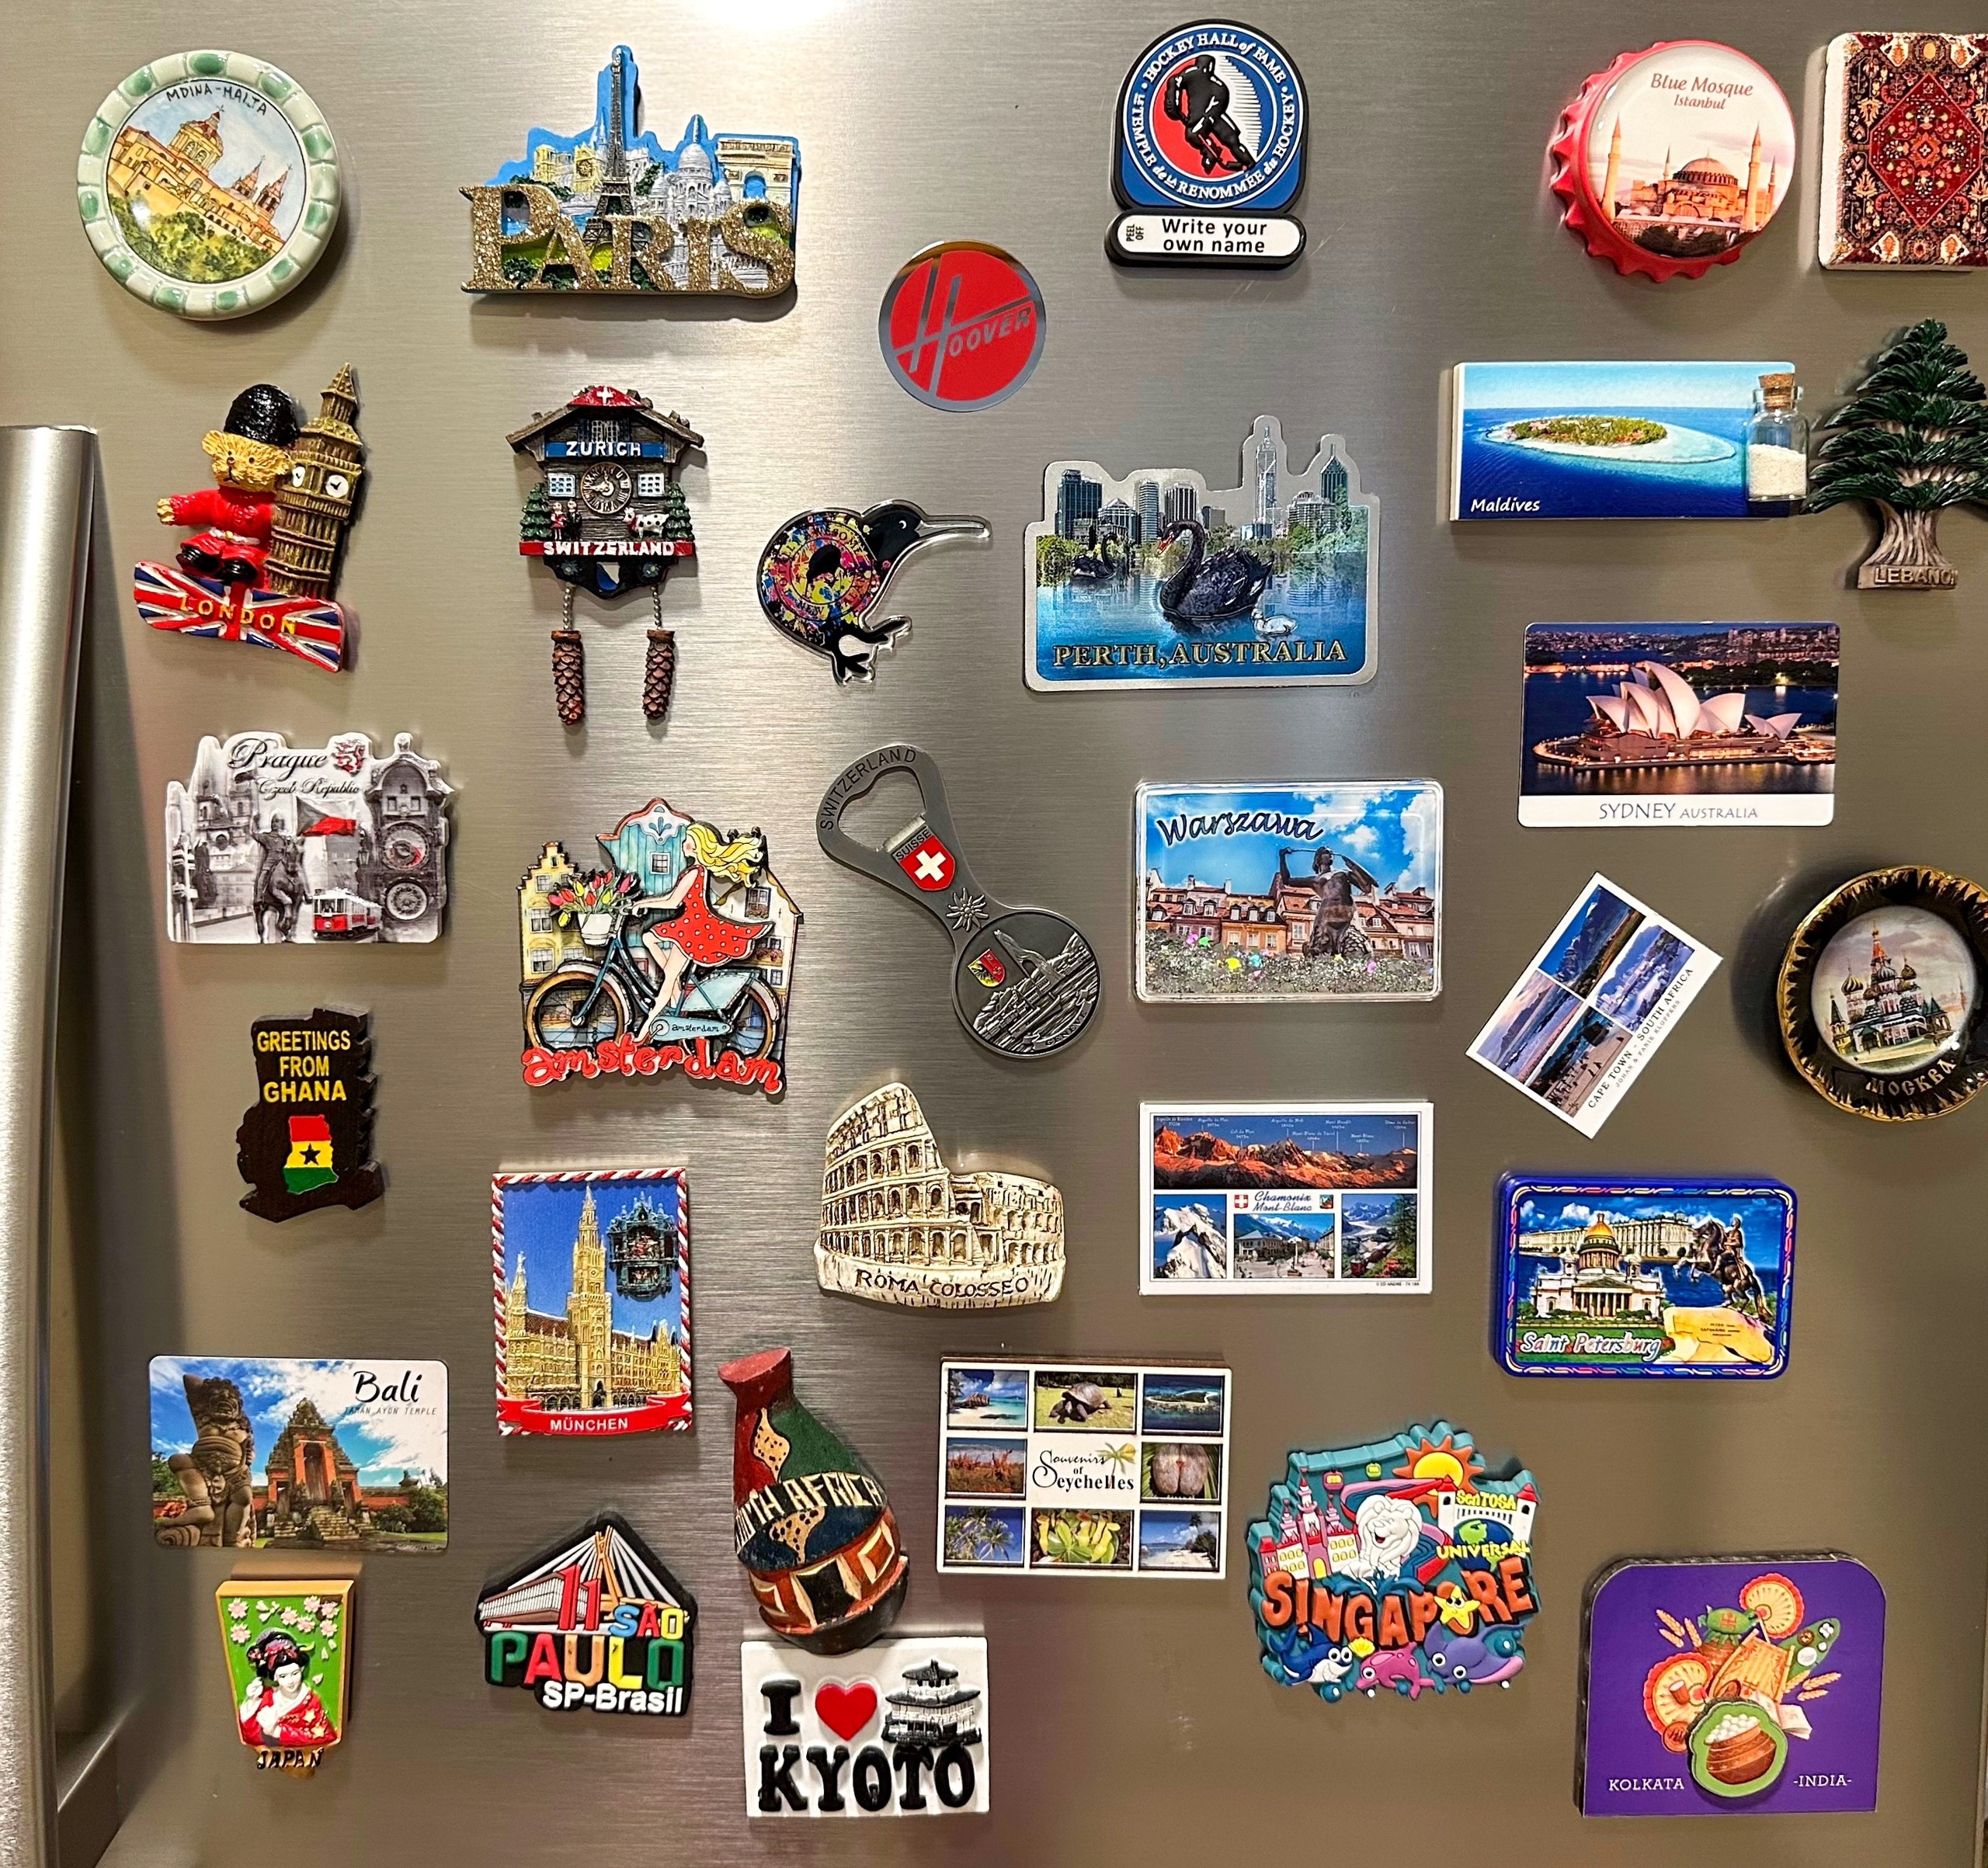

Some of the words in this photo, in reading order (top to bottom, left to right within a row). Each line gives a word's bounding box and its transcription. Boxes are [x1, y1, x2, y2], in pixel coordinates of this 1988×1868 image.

[1144, 39, 1194, 83] HOCKEY
[1197, 33, 1238, 47] HALL
[1238, 40, 1256, 54] of
[1255, 46, 1287, 83] FAME
[1650, 73, 1688, 90] Blue
[1691, 76, 1753, 97] Mosque
[1673, 94, 1726, 109] Istanbul
[1131, 105, 1157, 167] TEMPLE
[1152, 165, 1167, 180] de
[1176, 169, 1266, 199] RENOMMÉE
[1263, 159, 1278, 175] du
[1274, 92, 1295, 158] HOCKEY
[461, 184, 798, 293] PARIS
[1125, 224, 1135, 241] PEEL
[1135, 225, 1145, 241] OFF
[1162, 217, 1216, 234] Write
[1223, 220, 1267, 238] your
[1163, 239, 1204, 252] own
[1211, 239, 1266, 252] name
[565, 442, 641, 457] ZURICH
[1470, 497, 1541, 512] Maldives
[543, 540, 676, 557] SWITZERLAND
[179, 595, 297, 634] LONDON
[228, 738, 327, 781] Prague
[255, 777, 297, 800] Czech
[300, 779, 360, 796] Republic
[820, 748, 917, 831] SWITZERLAND
[1599, 803, 1676, 820] SYDNEY
[1680, 807, 1758, 819] AUSTRALIA
[1158, 810, 1324, 846] Warszawa
[895, 828, 932, 862] SUISSE
[672, 1021, 720, 1033] amsterdam
[1588, 1082, 1610, 1108] CAPE
[1608, 1050, 1632, 1080] TOWN
[1636, 1006, 1664, 1041] SOUTH
[1666, 969, 1694, 1005] AFRICA
[257, 1029, 352, 1053] GREETINGS
[280, 1055, 330, 1078] FROM
[1615, 1064, 1634, 1088] JOHAN
[1865, 1057, 1957, 1095] МОСКВА
[263, 1079, 347, 1103] GHANA
[1253, 1202, 1312, 1212] Mont-Blanc
[1254, 1190, 1312, 1202] Chamonix
[855, 1268, 920, 1295] ROMA
[929, 1276, 1029, 1299] COLOSSEO
[1521, 1331, 1570, 1354] Saint
[1571, 1331, 1662, 1362] Petersburg
[353, 1370, 422, 1403] Bali
[345, 1406, 370, 1415] TAMAN
[405, 1406, 437, 1415] TEMPLE
[549, 1415, 629, 1432] MÜNCHEN
[1032, 1460, 1135, 1493] Seychelles
[1073, 1466, 1084, 1474] of
[1437, 1540, 1531, 1559] UNIVERSAL
[608, 1602, 685, 1641] SÃO
[489, 1630, 685, 1690] PAULO
[542, 1681, 684, 1713] SP-Brasil
[759, 1678, 801, 1735] I
[257, 1748, 325, 1769] JAPAN
[758, 1743, 975, 1812] KYOTO
[1608, 1777, 1684, 1792] KOLKATA
